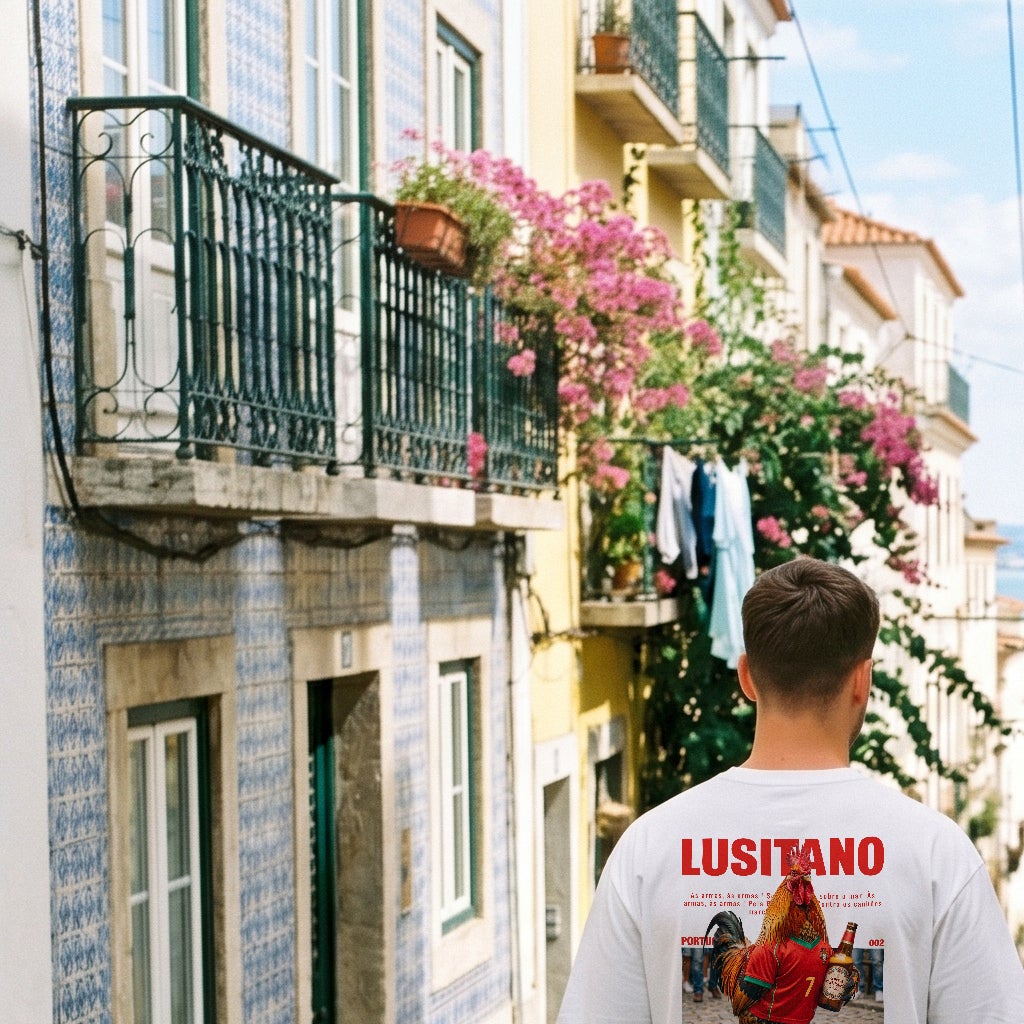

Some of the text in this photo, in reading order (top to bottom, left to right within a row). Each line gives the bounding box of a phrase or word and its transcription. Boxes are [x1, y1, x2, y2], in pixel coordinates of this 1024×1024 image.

[681, 836, 885, 877] LUSITANO
[868, 938, 885, 947] 002
[804, 976, 816, 998] 7
